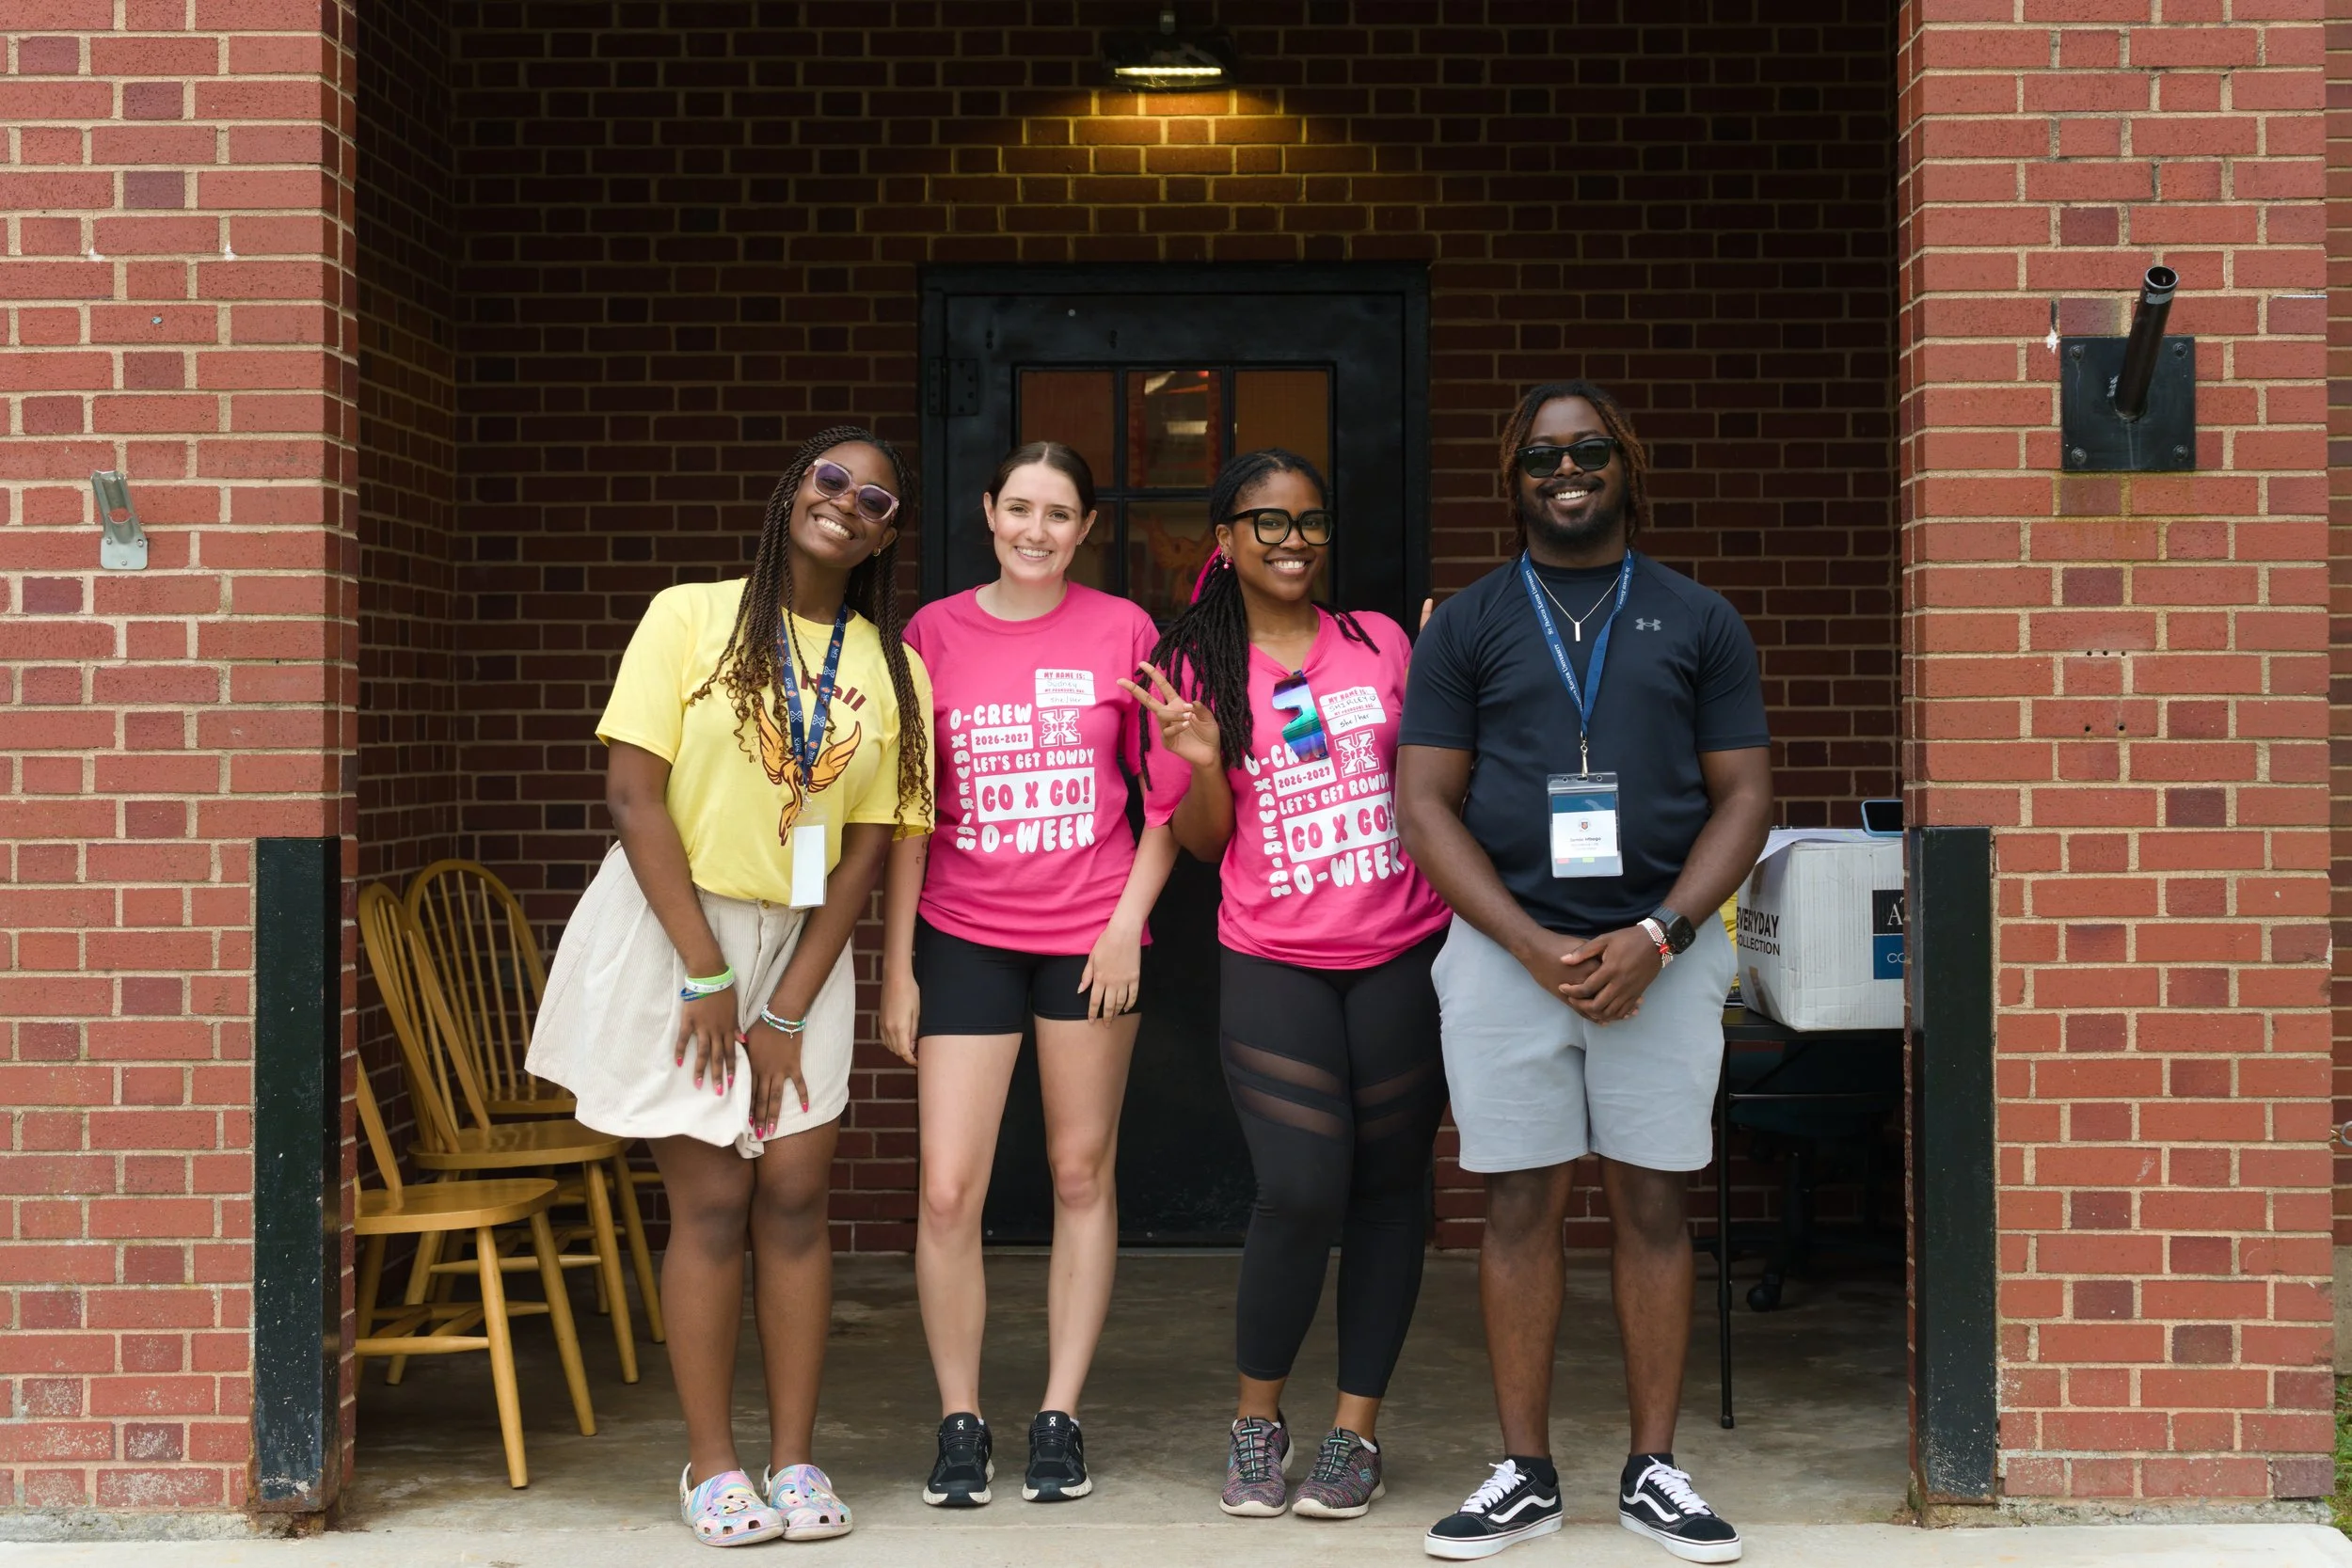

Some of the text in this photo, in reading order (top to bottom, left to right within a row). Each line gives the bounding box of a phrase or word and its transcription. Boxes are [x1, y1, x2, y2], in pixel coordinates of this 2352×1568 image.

[949, 703, 1033, 731] O-CREW
[975, 733, 1029, 746] 2026-2027
[973, 748, 1095, 773] LET'S GET ROWDY
[1278, 766, 1330, 788] 2026-2027
[982, 776, 1090, 812] GO X GO!
[1279, 771, 1390, 815] LET'S GET ROWDY
[981, 814, 1096, 854] O-WEEK
[1292, 822, 1323, 852] GO
[1332, 814, 1348, 843] X
[1293, 839, 1406, 895] O-WEEK
